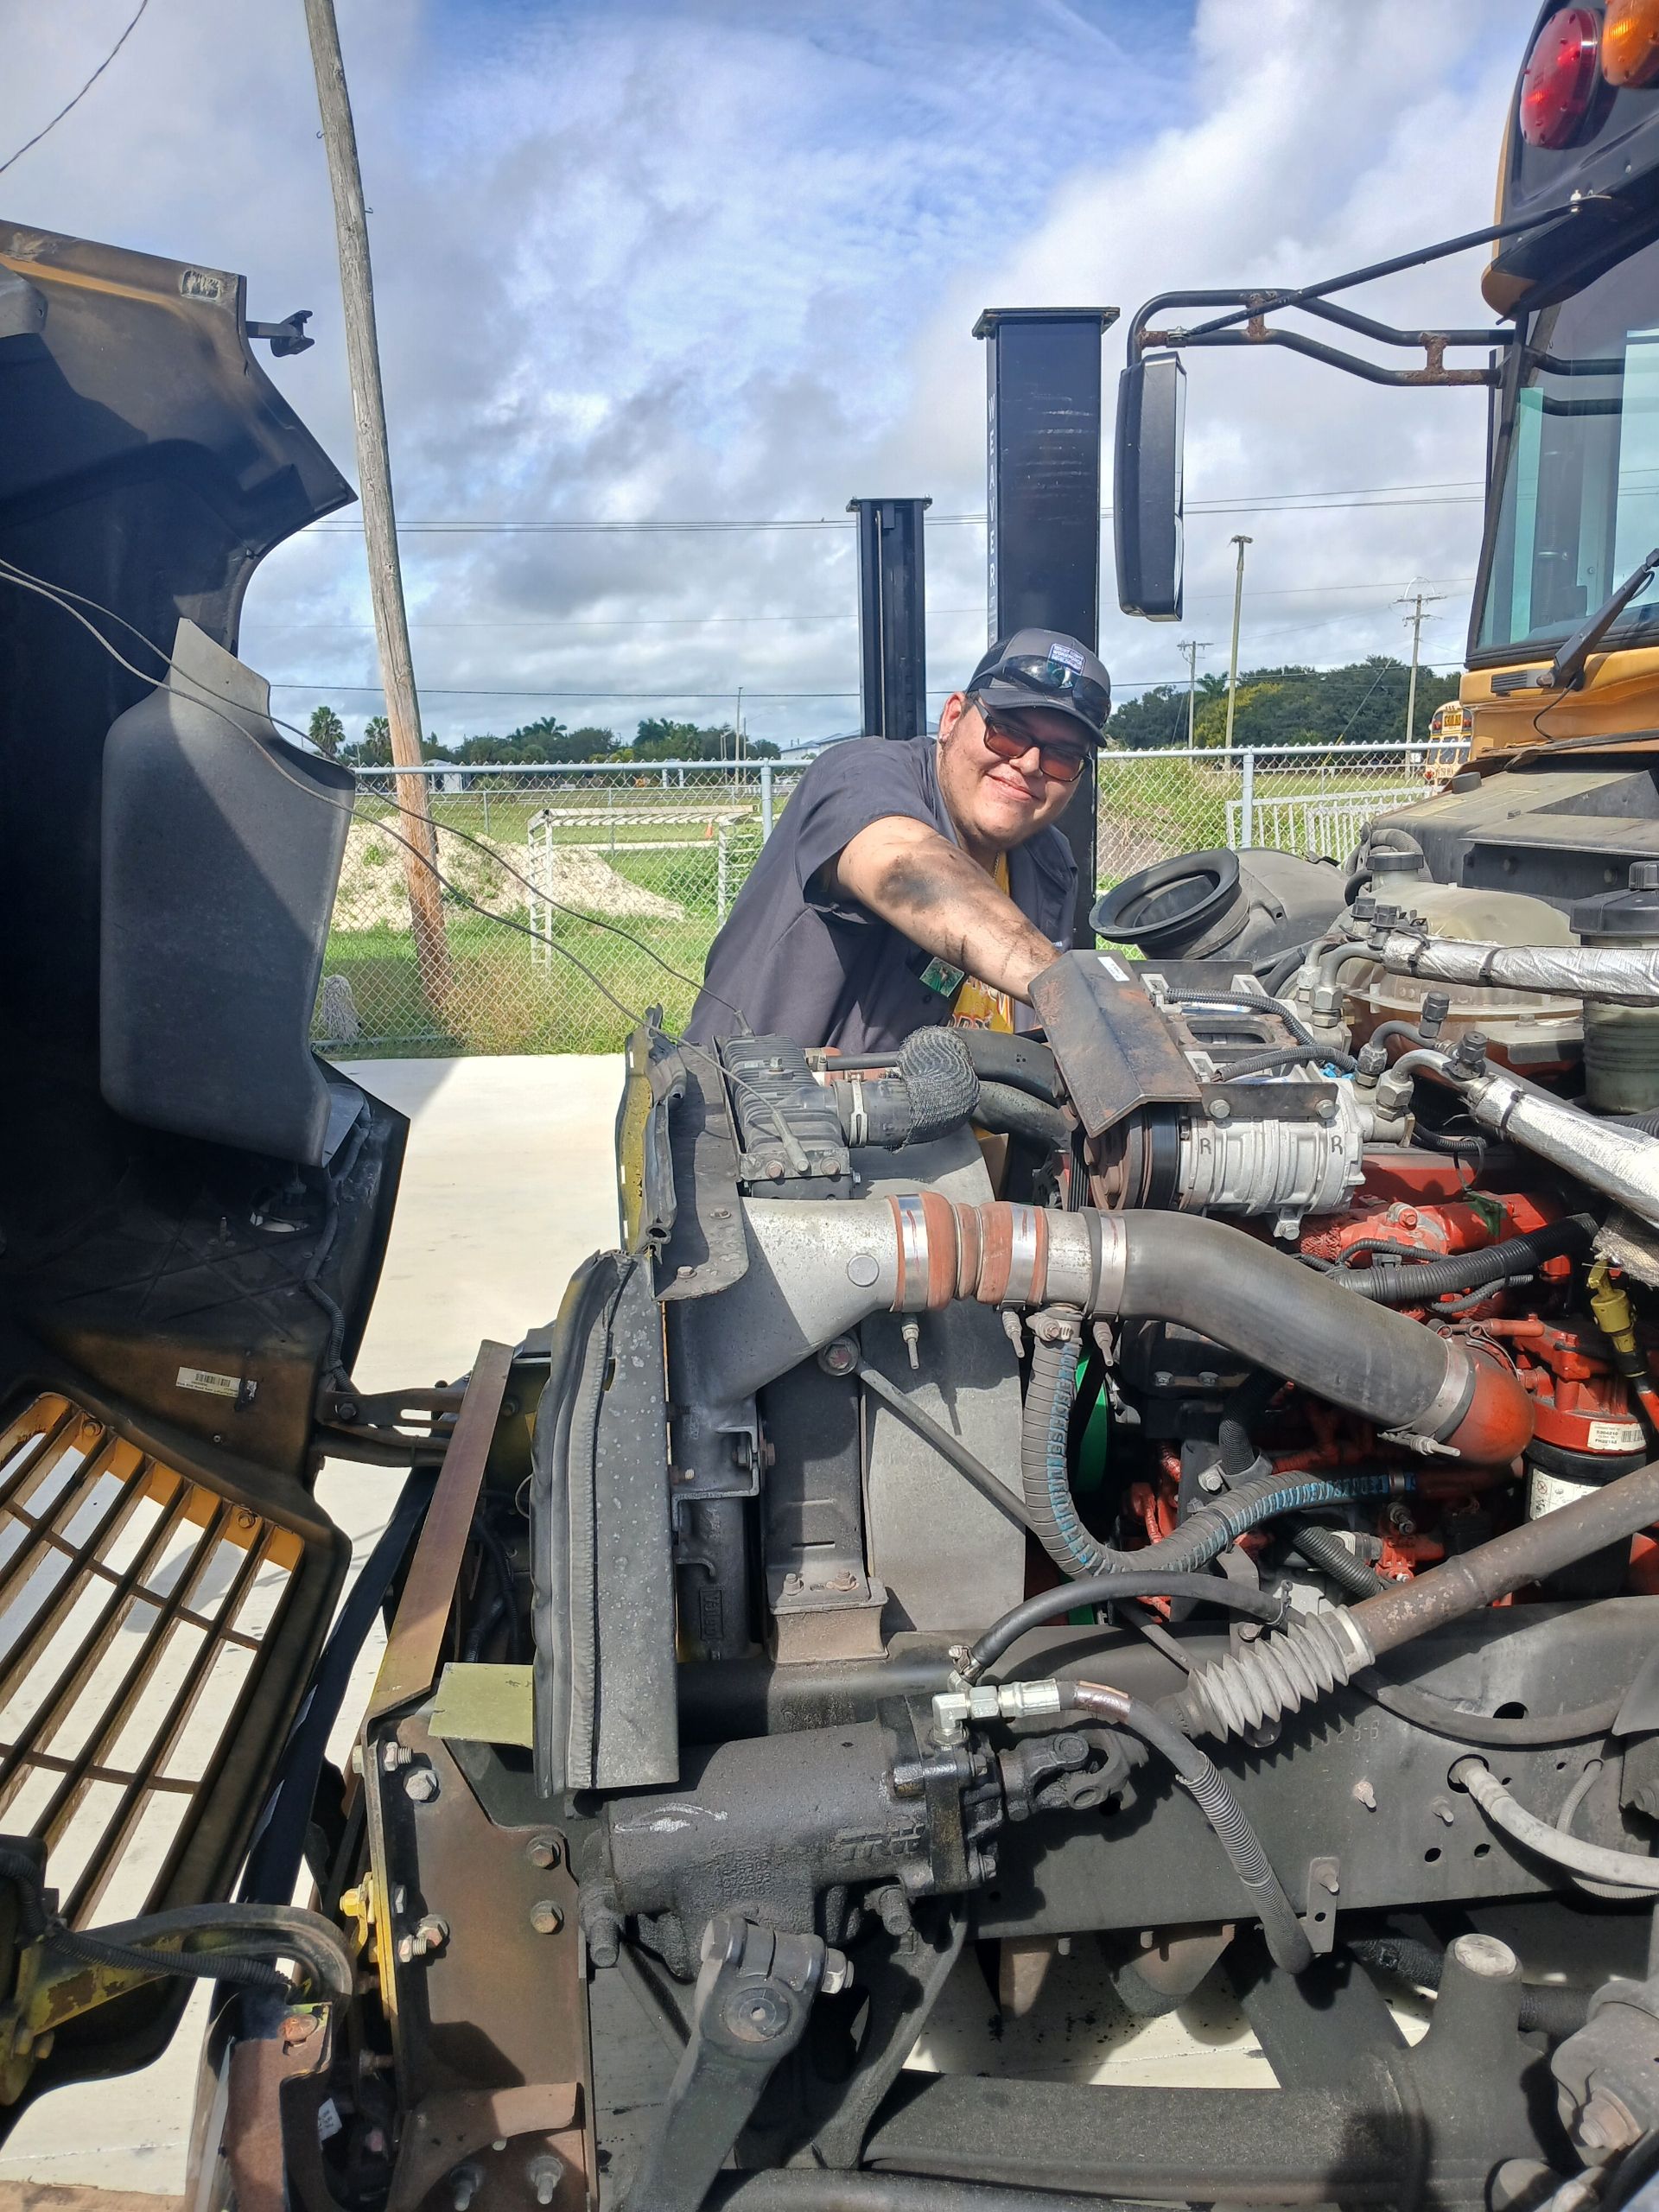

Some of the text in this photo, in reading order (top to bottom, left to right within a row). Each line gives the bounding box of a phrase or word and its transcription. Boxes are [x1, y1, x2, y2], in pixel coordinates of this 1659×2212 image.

[988, 393, 996, 588] WEAVER
[1199, 1137, 1212, 1154] R
[1331, 1135, 1344, 1155] R
